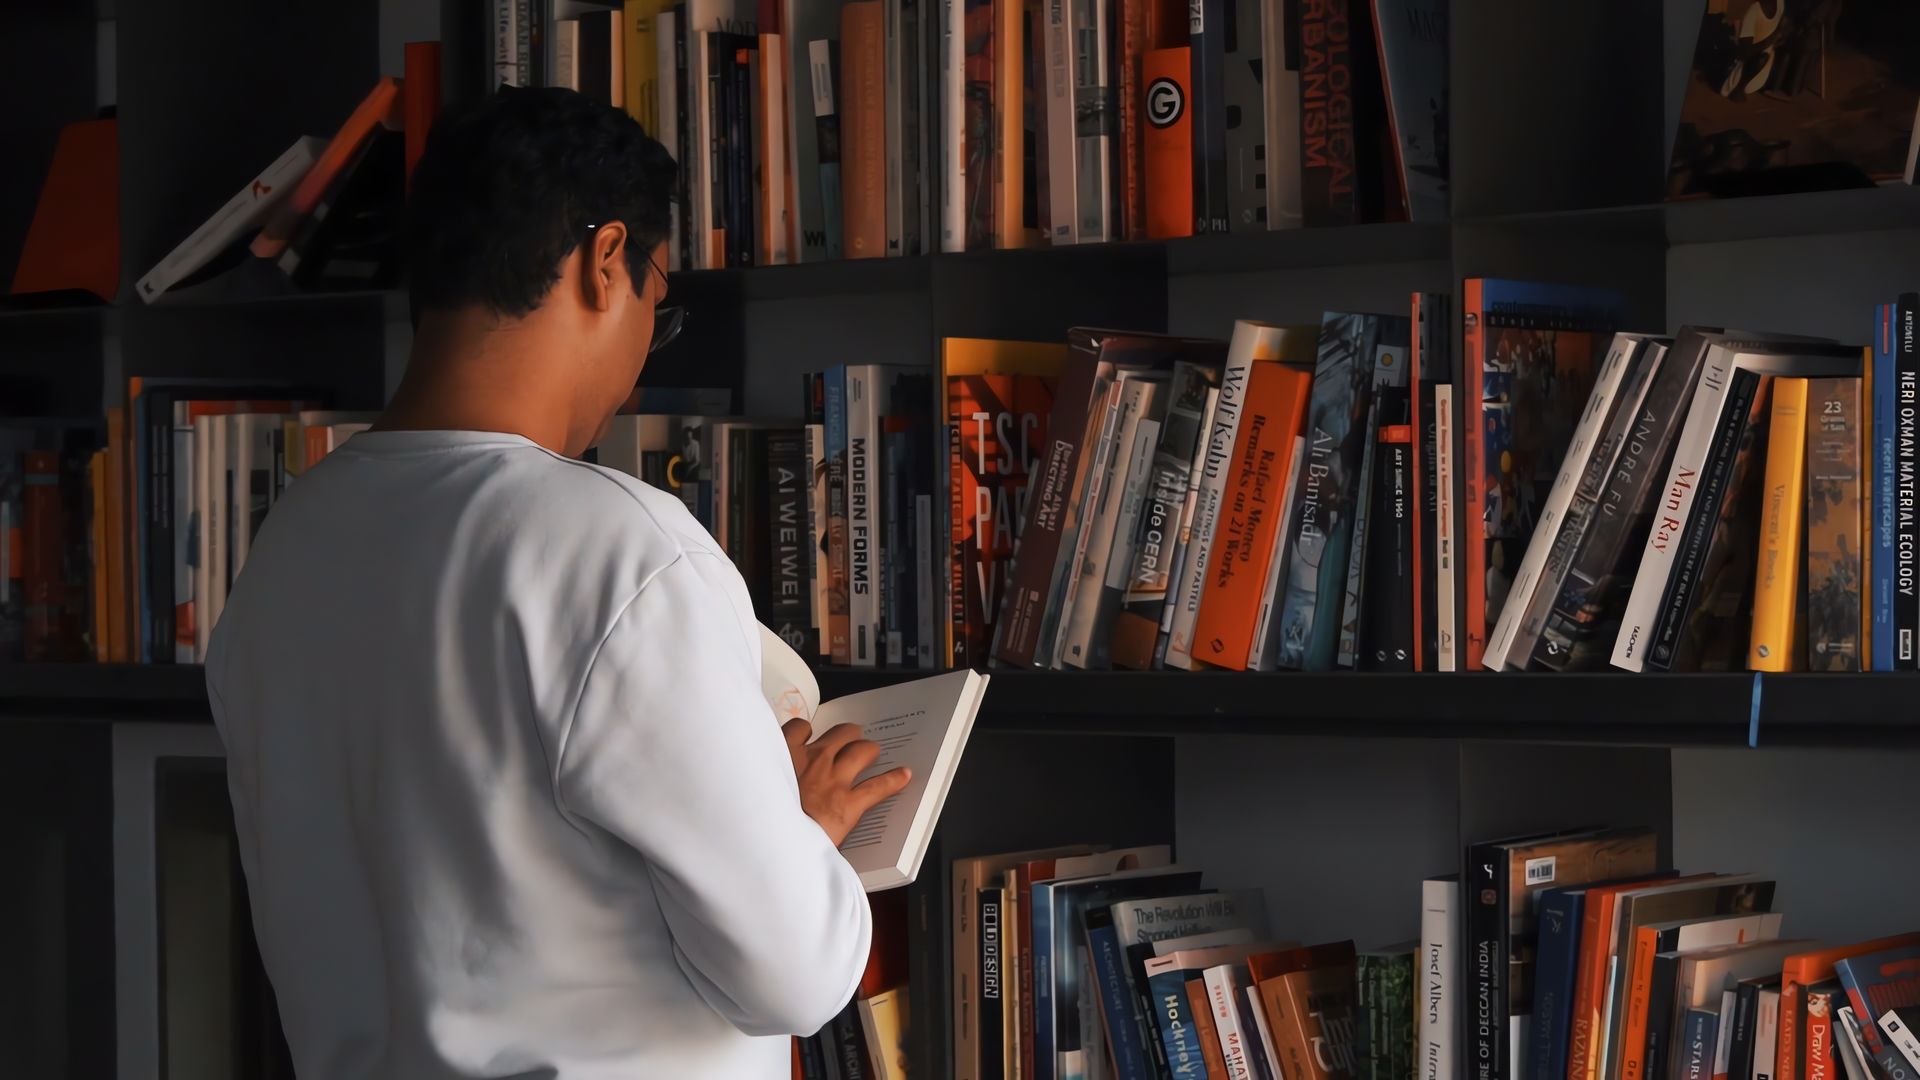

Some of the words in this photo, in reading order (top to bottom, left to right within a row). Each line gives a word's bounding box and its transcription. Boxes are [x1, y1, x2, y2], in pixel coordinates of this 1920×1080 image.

[1218, 365, 1245, 418] Wolf
[1823, 400, 1842, 414] 23
[1900, 370, 1916, 404] NERI
[1205, 423, 1233, 478] Kahn
[1239, 417, 1266, 486] Remarks
[1311, 426, 1334, 460] Ali
[1616, 409, 1658, 484] ANDRÉ
[1882, 437, 1893, 475] recent
[1899, 407, 1916, 458] OXMAN
[778, 466, 797, 493] AI
[852, 438, 867, 520] MODERN
[1148, 470, 1176, 527] Inside
[1251, 451, 1275, 502] Rafael
[1666, 465, 1695, 513] Man
[1898, 460, 1915, 530] MATERIAL
[1233, 492, 1248, 514] on
[1298, 463, 1330, 548] Banisadr
[1601, 488, 1623, 518] FU
[1879, 475, 1893, 548] waterscapes
[779, 500, 800, 606] WEIWEI
[853, 526, 869, 595] FORMS
[1137, 530, 1164, 583] CERN
[1648, 515, 1680, 557] Ray
[1217, 540, 1239, 589] Works
[1897, 533, 1914, 596] ECOLOGY
[984, 904, 997, 941] BOLD
[1134, 907, 1154, 925] The
[1154, 904, 1205, 923] Revolution
[985, 945, 998, 997] DESIGN
[1430, 943, 1443, 979] Josef
[1479, 940, 1488, 977] INDIA
[1429, 981, 1442, 1024] Albers
[1479, 981, 1488, 1036] DECCAN
[1164, 994, 1196, 1080] Hockney'
[1479, 1039, 1489, 1059] OF
[1812, 1025, 1826, 1061] Draw
